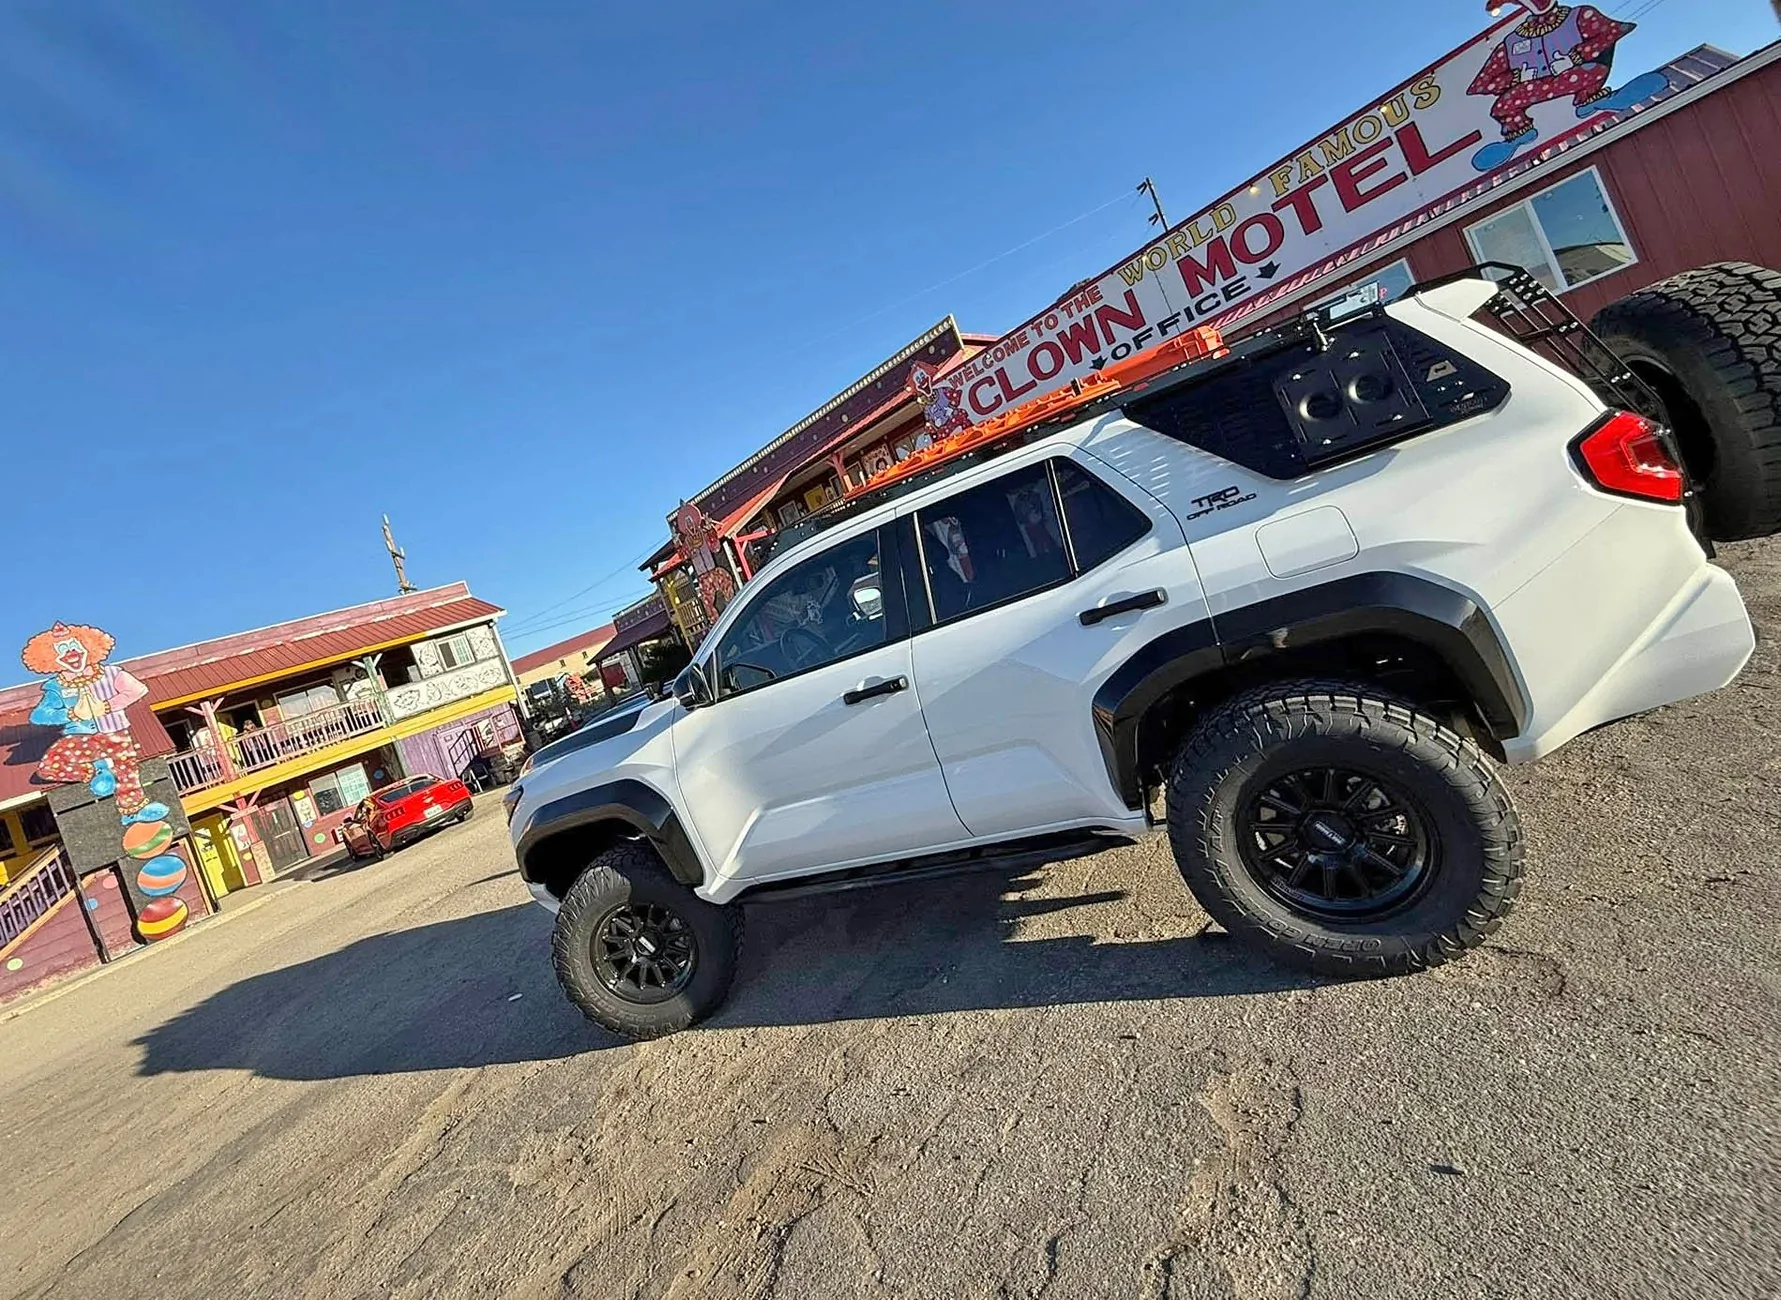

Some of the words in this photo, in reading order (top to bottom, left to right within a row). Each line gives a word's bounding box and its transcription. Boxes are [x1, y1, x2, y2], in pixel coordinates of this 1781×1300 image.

[1117, 202, 1237, 287] WORLD
[1268, 74, 1441, 198] FAMOUS
[967, 288, 1147, 416] CLOWN
[1176, 120, 1483, 299] MOTEL
[950, 330, 1031, 390] WELCOME
[1031, 312, 1059, 340] TO
[1061, 284, 1104, 318] THE
[1111, 275, 1252, 362] OFFICE
[1186, 507, 1214, 520] OFF
[1216, 493, 1257, 510] ROAD
[1191, 485, 1240, 507] TRD
